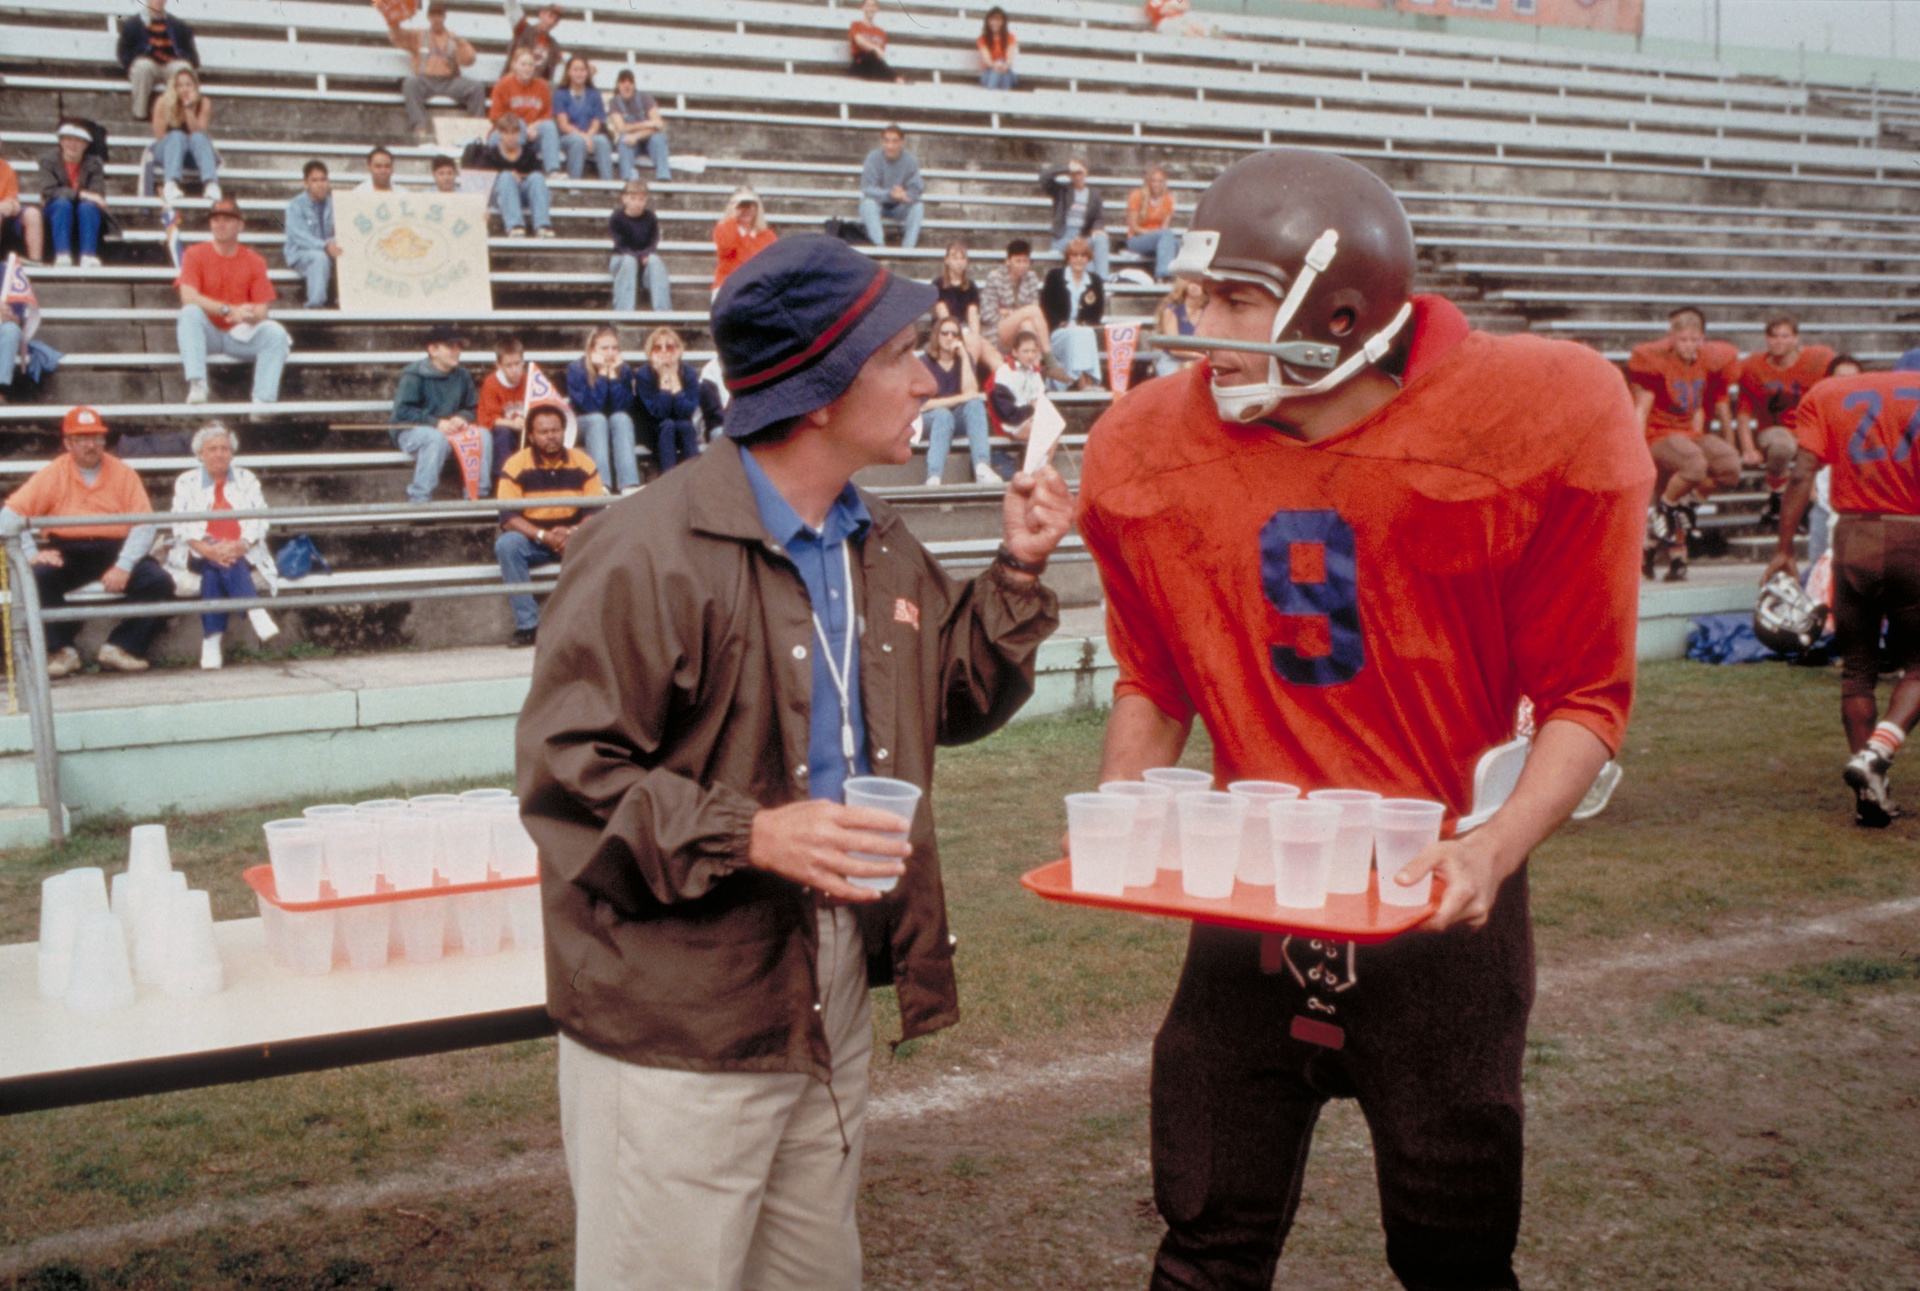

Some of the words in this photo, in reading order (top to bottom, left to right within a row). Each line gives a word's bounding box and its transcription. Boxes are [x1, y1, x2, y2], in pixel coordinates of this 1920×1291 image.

[12, 266, 28, 293] S
[532, 372, 549, 398] S
[1843, 387, 1920, 464] 27
[460, 430, 479, 479] LSU
[1259, 508, 1366, 687] 9
